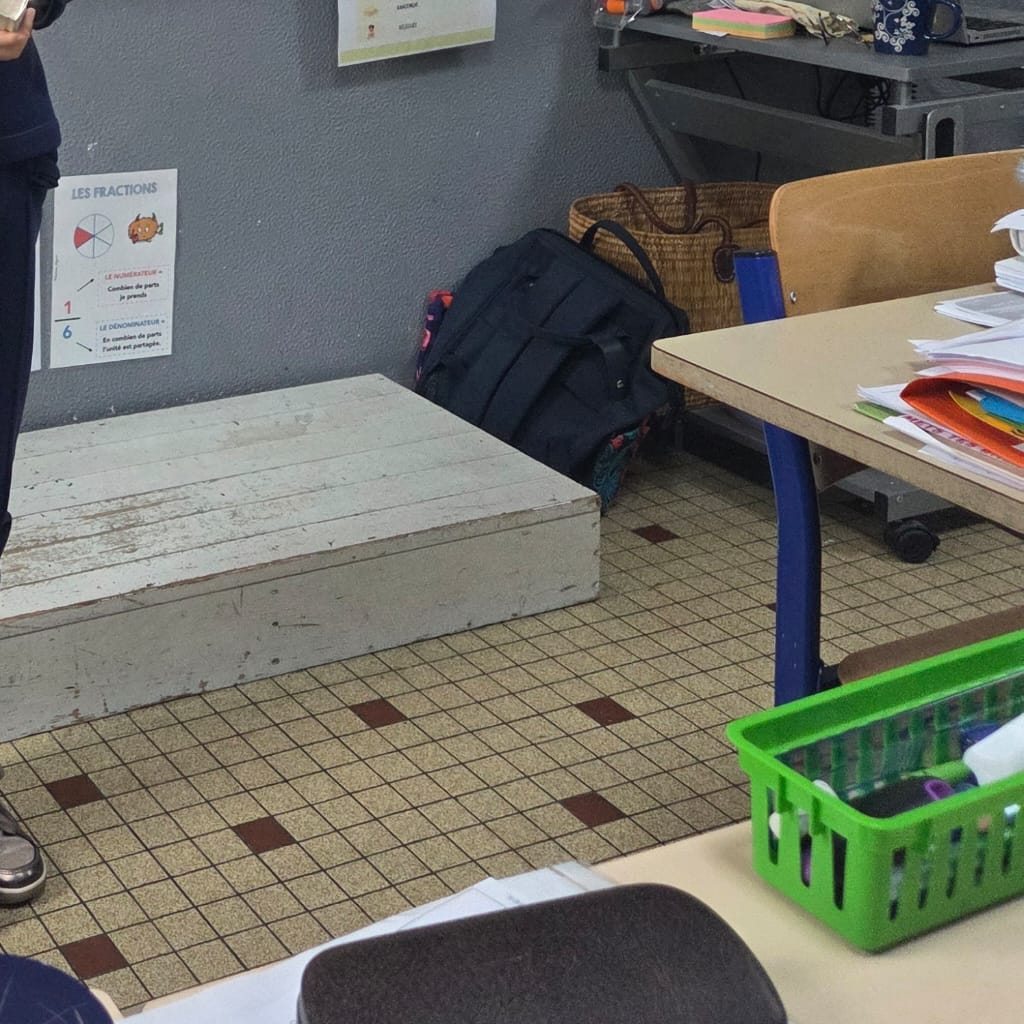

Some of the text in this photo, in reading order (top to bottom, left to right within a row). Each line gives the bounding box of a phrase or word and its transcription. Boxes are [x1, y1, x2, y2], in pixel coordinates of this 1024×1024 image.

[71, 182, 159, 200] LES FRACTIONS
[107, 282, 160, 293] Combien parts
[63, 300, 72, 315] 1
[62, 324, 73, 340] 6
